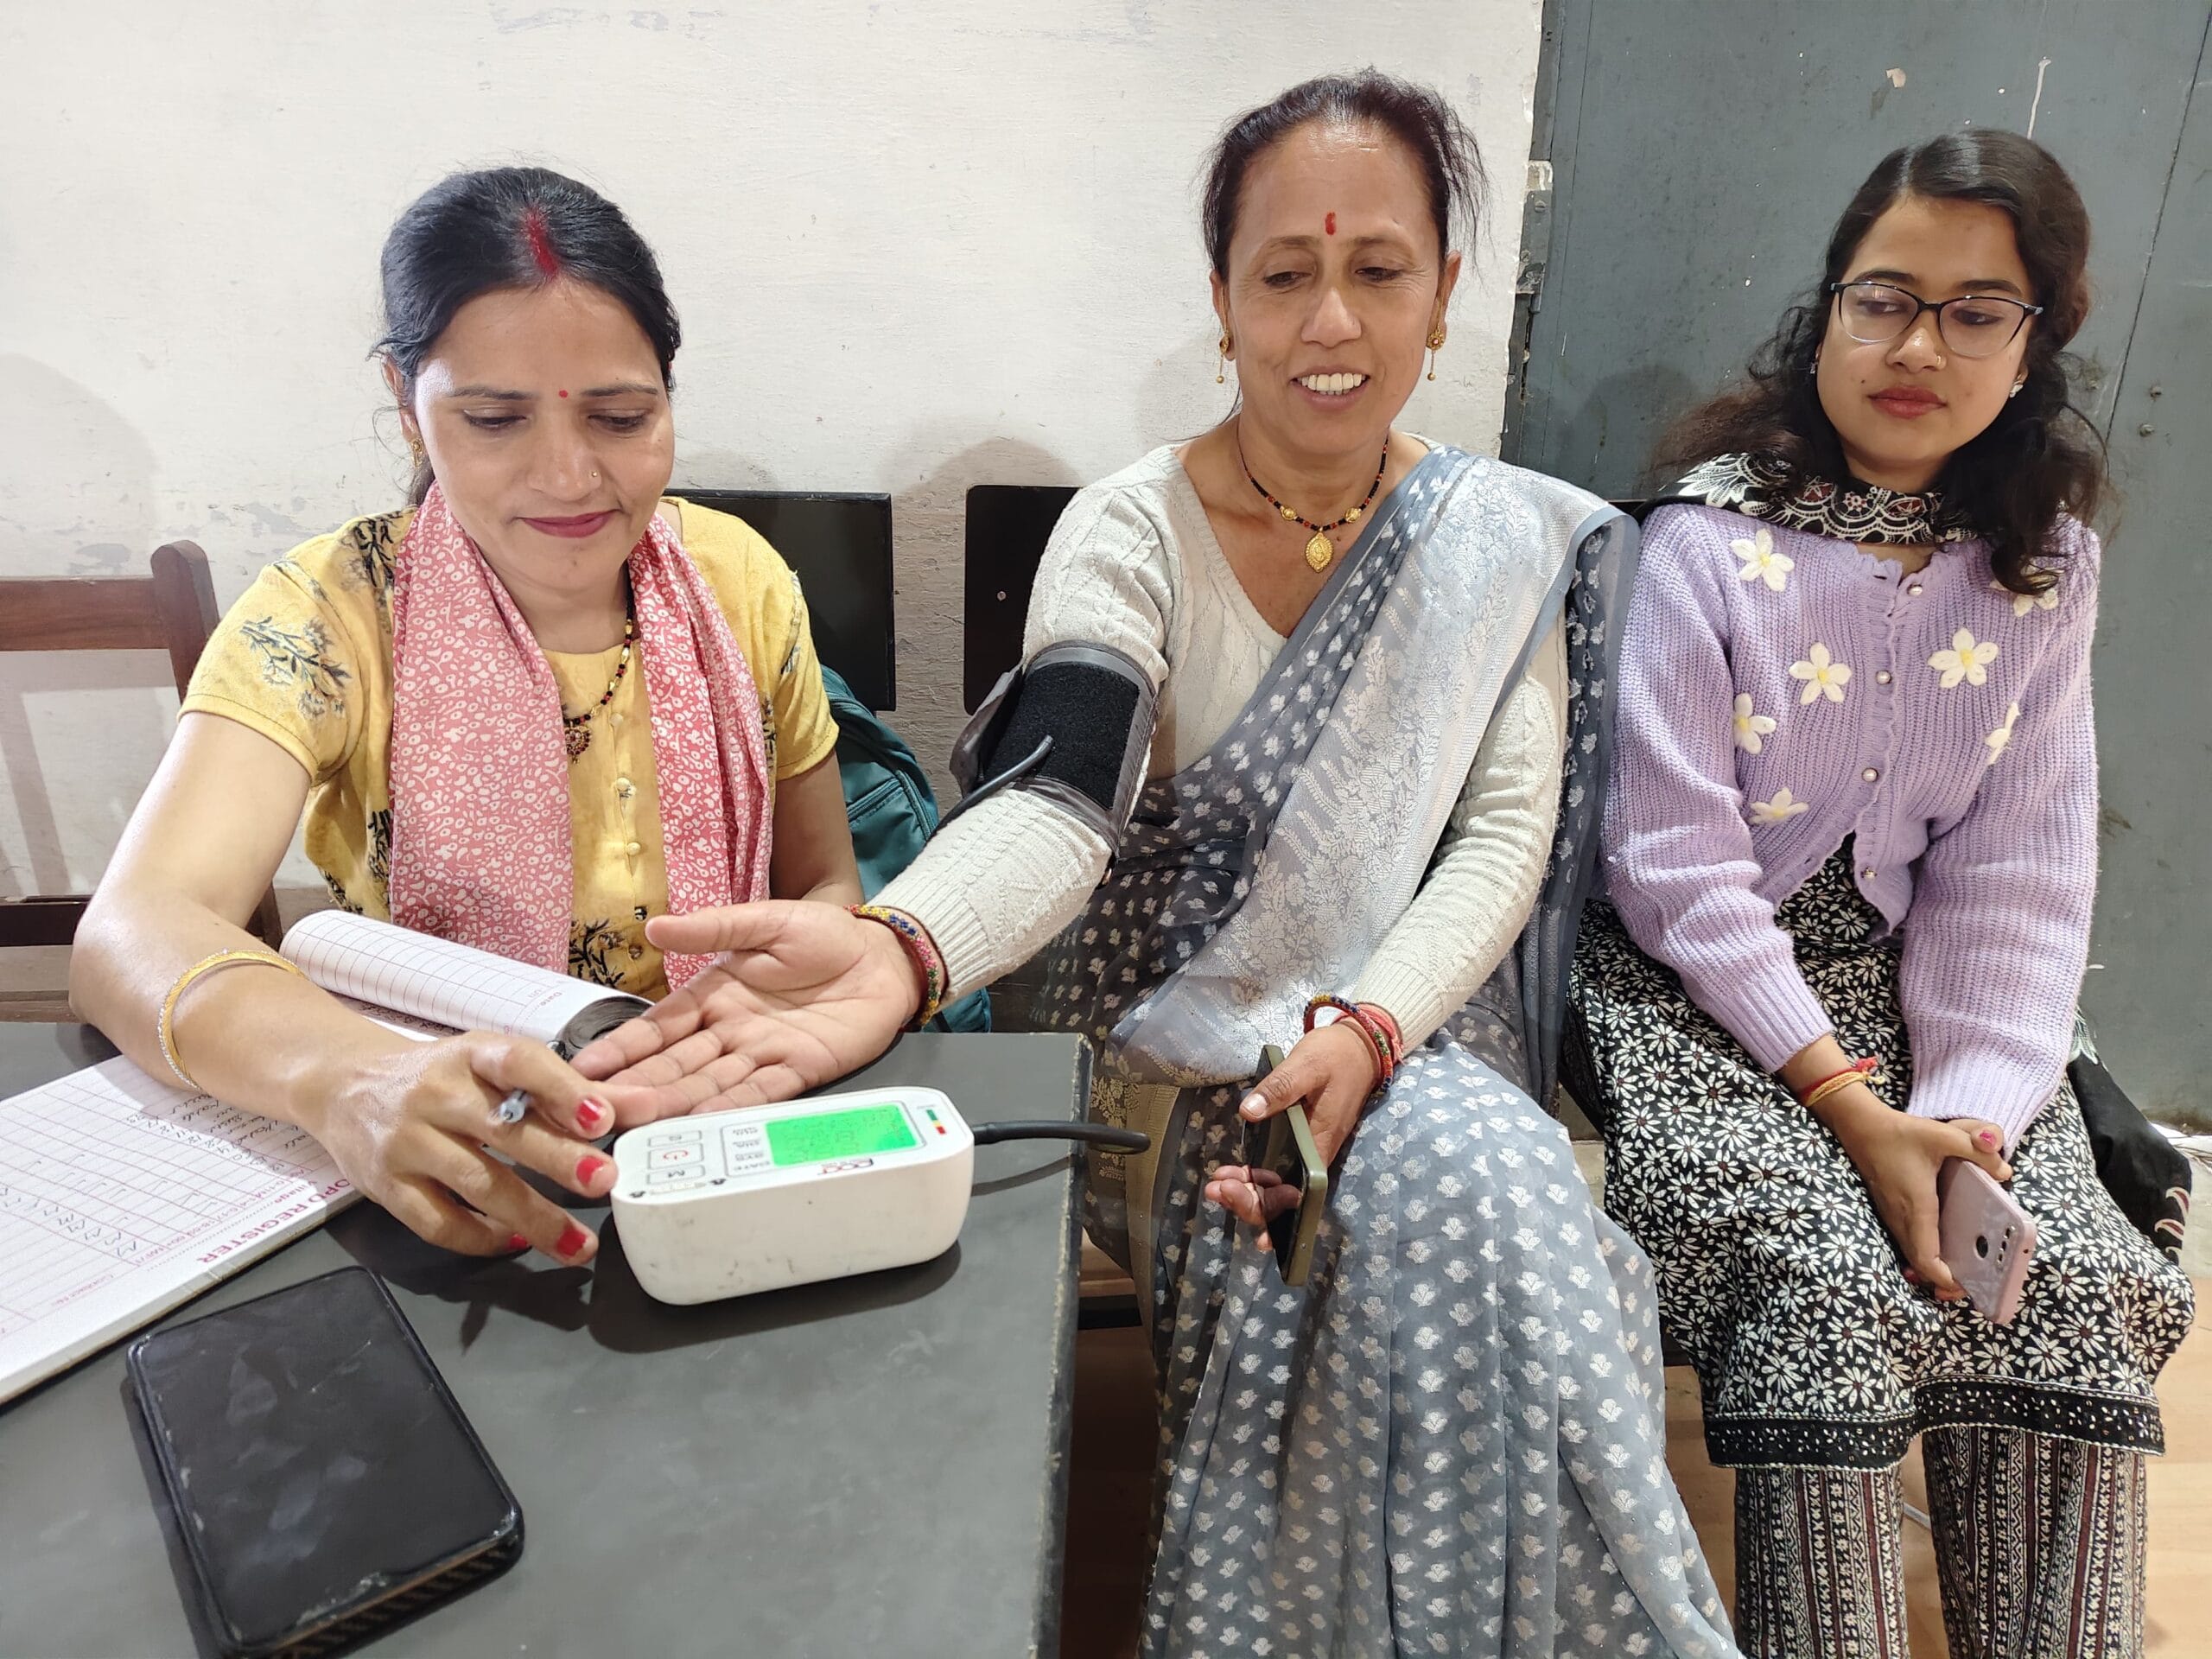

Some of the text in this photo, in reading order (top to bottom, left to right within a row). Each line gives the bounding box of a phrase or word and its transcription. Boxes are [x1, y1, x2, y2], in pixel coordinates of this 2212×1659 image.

[274, 1180, 318, 1204] Village
[197, 1179, 350, 1263] OPD REGISTER
